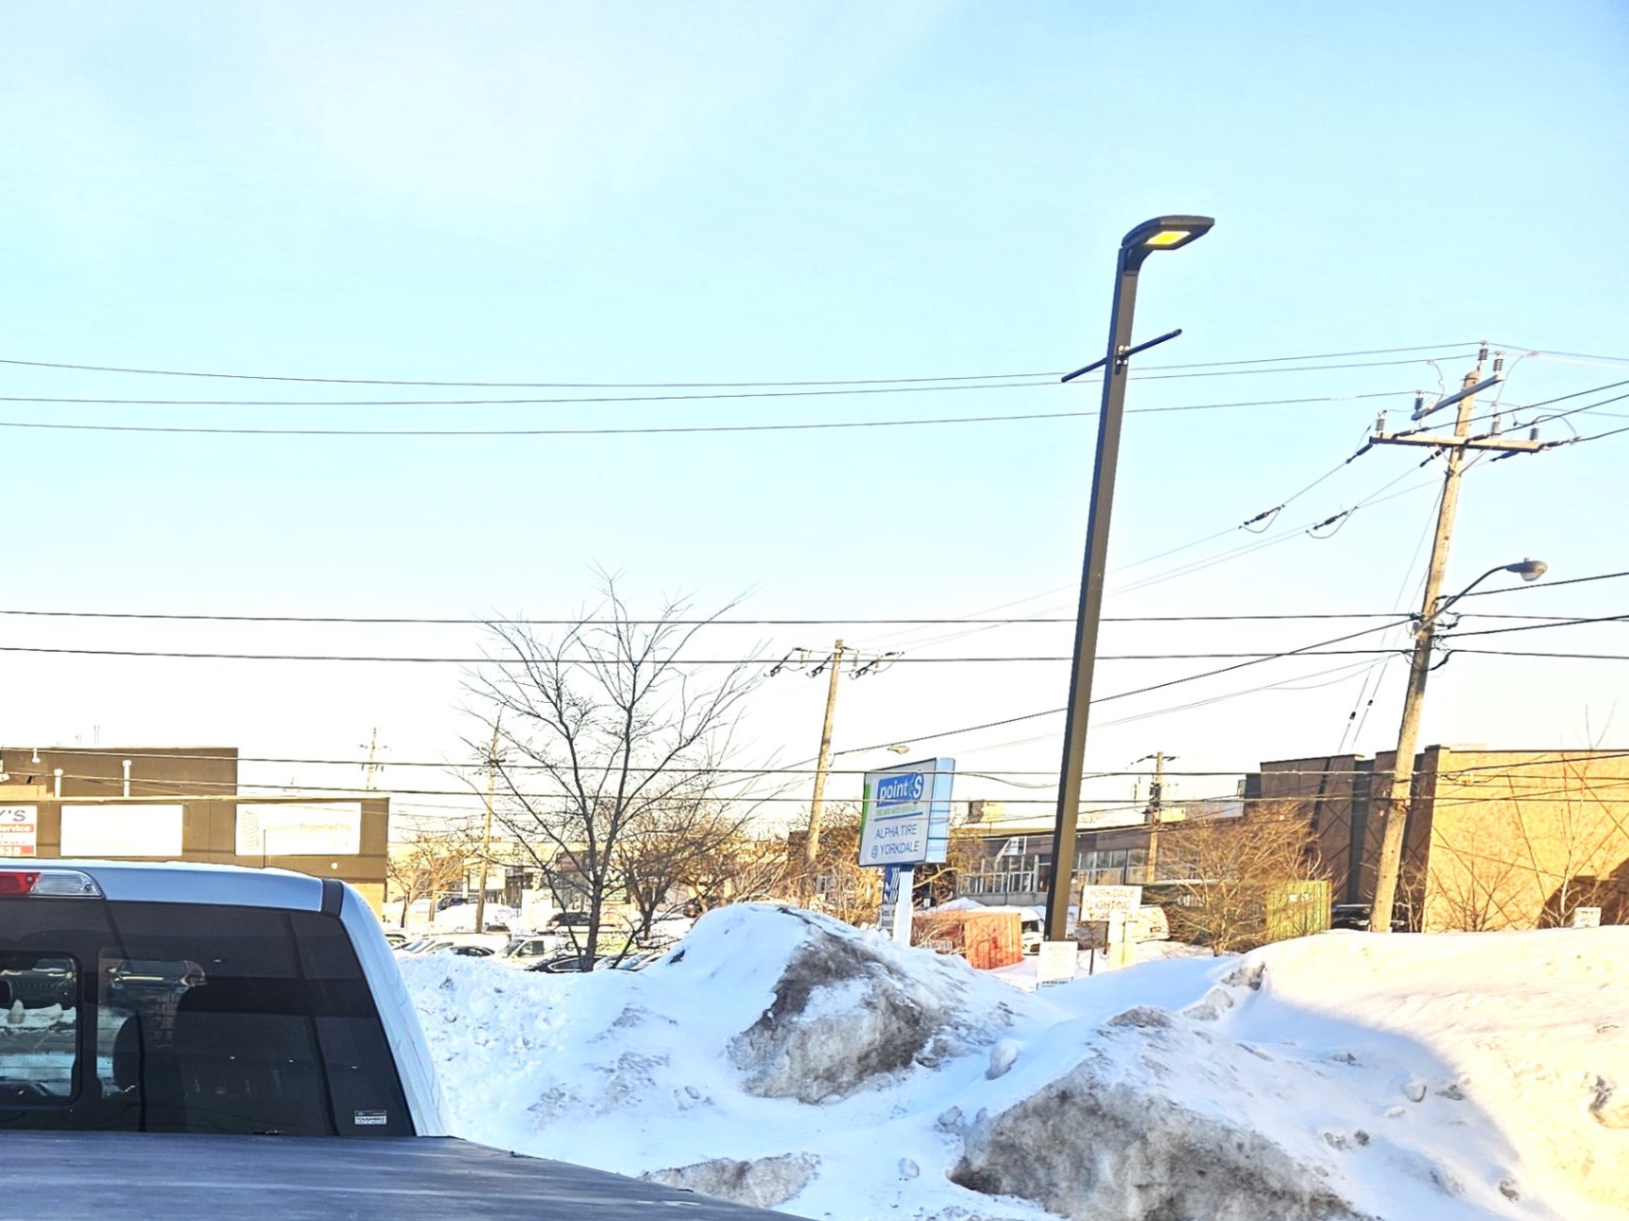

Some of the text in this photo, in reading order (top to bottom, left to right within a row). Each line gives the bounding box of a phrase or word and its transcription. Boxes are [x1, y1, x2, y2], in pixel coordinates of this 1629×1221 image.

[880, 780, 908, 804] point
[875, 824, 918, 839] ALPHA TIRE
[871, 841, 920, 859] @ YORKDALE
